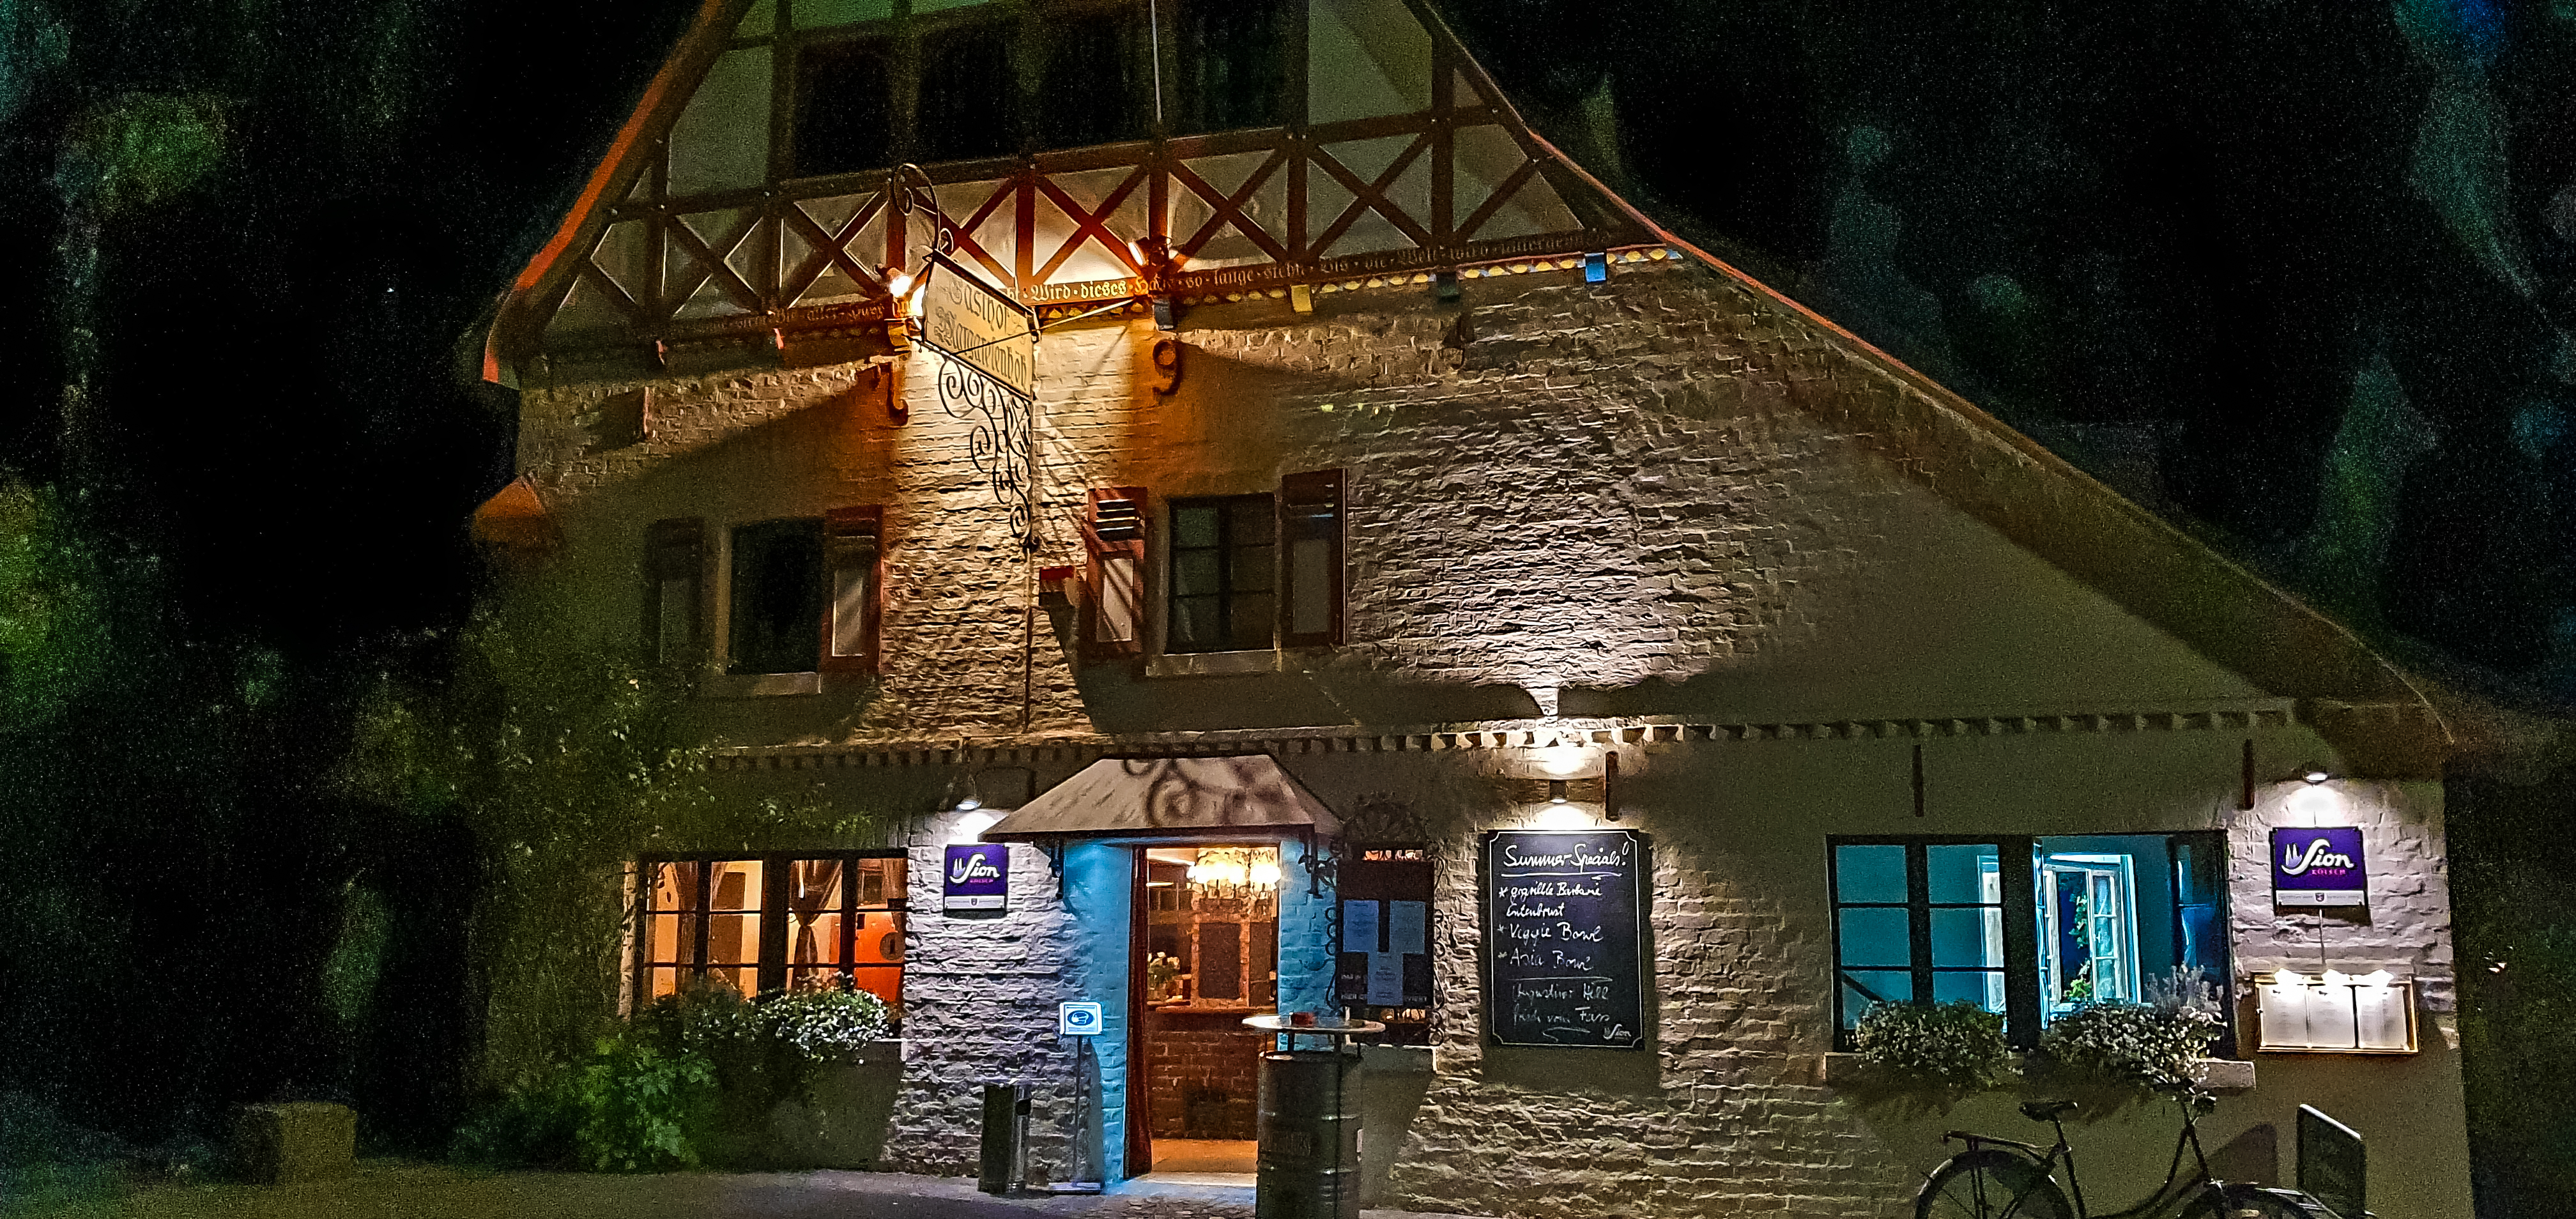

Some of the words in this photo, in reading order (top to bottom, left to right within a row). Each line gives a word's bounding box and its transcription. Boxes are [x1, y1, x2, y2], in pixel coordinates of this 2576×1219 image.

[1031, 284, 1071, 302] Wird
[1080, 280, 1127, 300] dieses
[949, 854, 1000, 884] Sion
[2281, 838, 2355, 875] Sion
[1510, 923, 1552, 946] Veggie
[1556, 921, 1604, 942] Bowl
